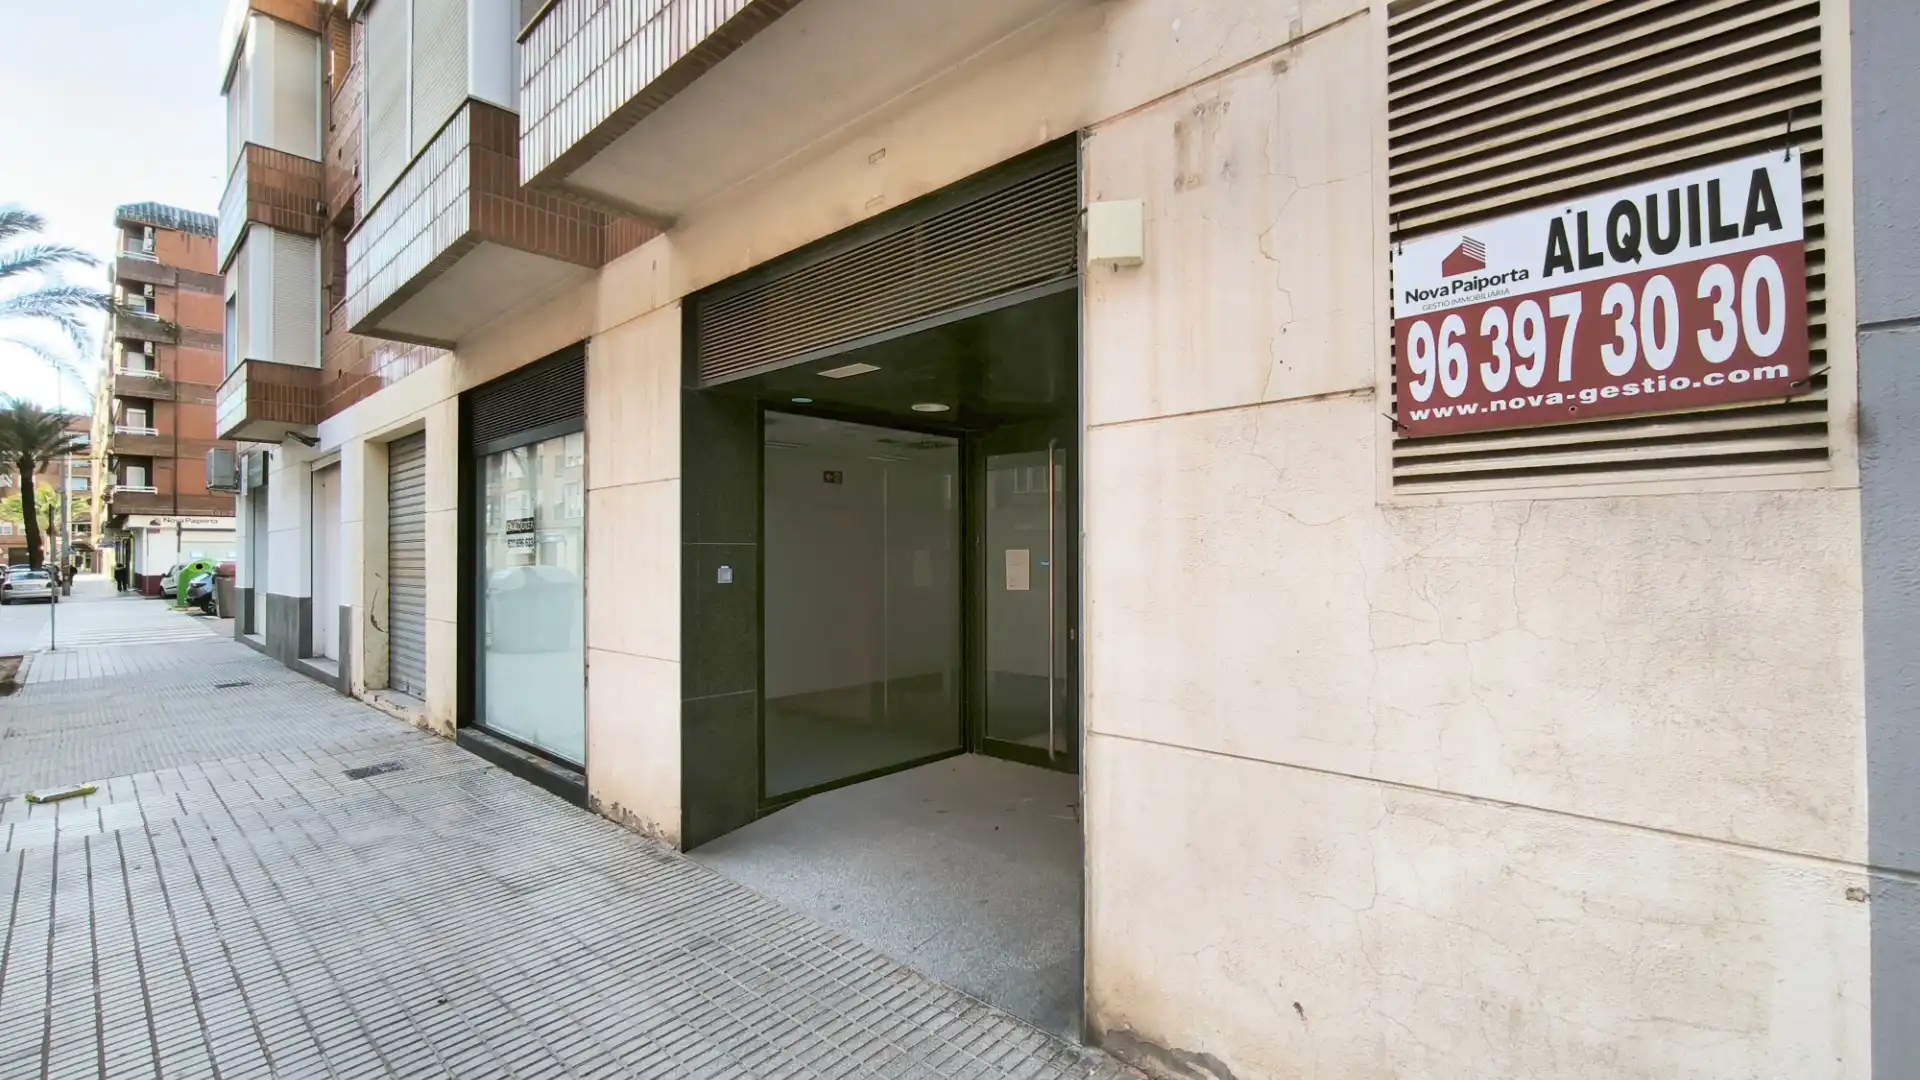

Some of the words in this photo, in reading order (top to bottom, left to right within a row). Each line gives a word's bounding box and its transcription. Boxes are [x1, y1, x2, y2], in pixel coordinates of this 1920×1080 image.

[1542, 167, 1783, 278] ALQUILA
[1405, 285, 1449, 304] Nova
[1451, 268, 1529, 295] Paiporta
[1406, 313, 1469, 402] 96
[1479, 290, 1583, 393] 397
[1599, 274, 1680, 377] 30
[1696, 254, 1786, 364] 30
[1409, 364, 1789, 422] www.nova-gestio.com
